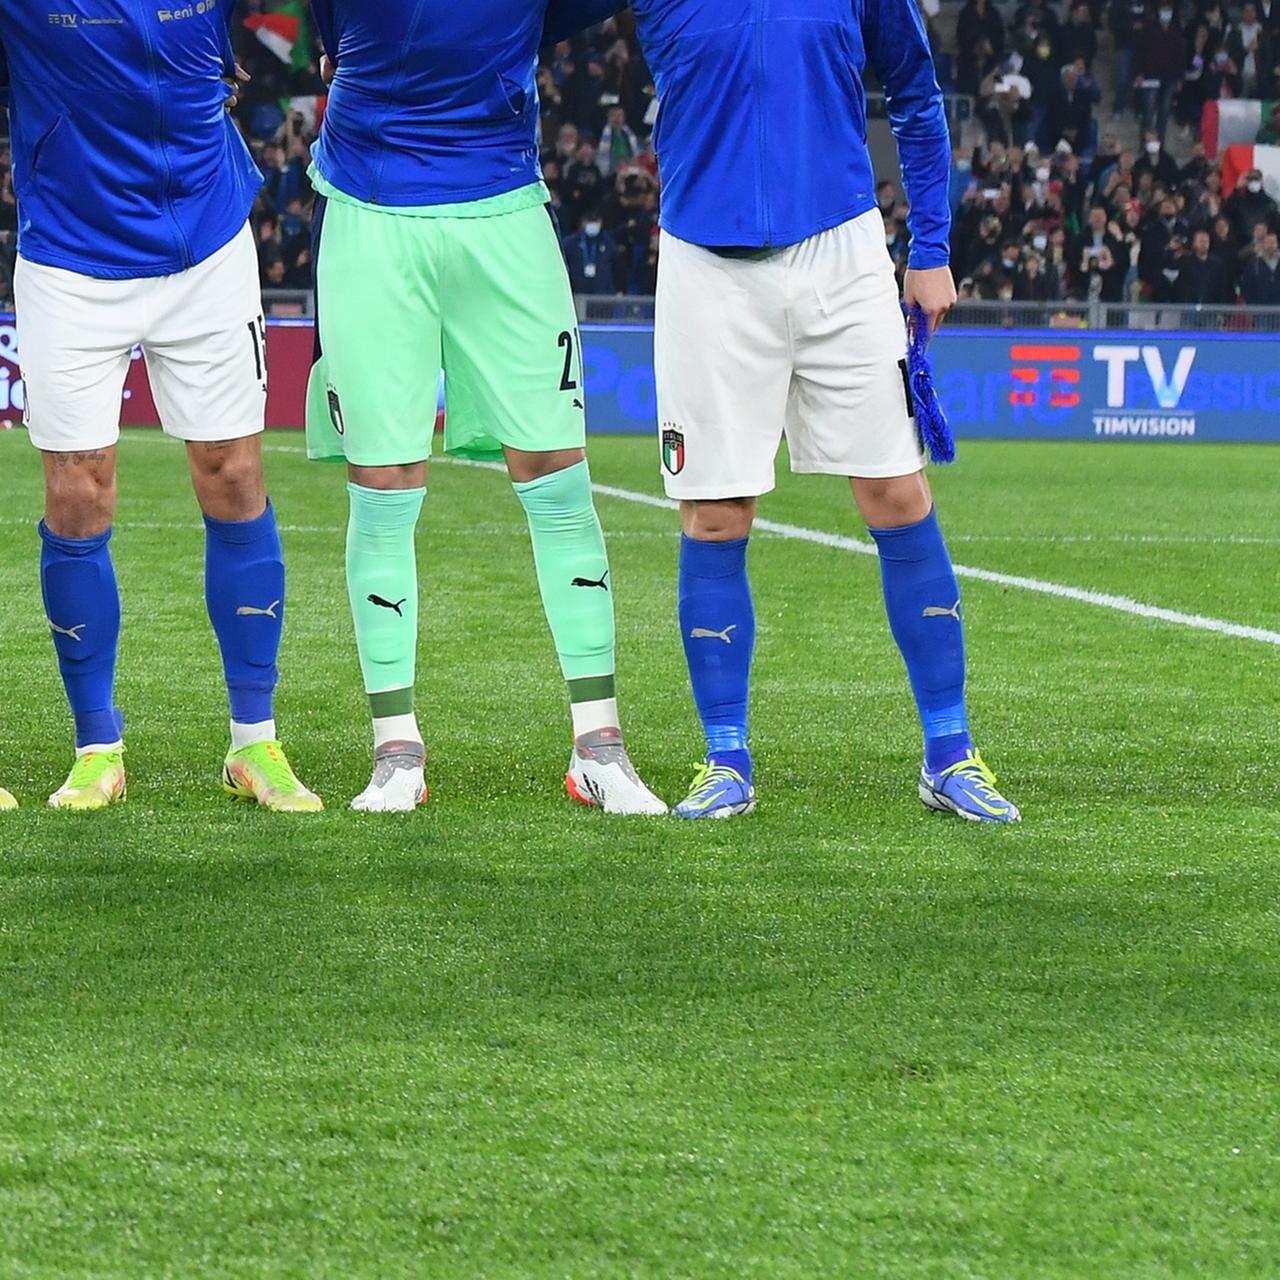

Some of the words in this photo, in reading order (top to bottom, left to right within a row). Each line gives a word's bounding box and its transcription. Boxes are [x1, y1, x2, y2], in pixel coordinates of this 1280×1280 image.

[62, 14, 77, 24] TV
[174, 4, 194, 20] eni
[1093, 346, 1197, 409] TV
[897, 358, 914, 419] 1
[1093, 417, 1196, 436] TIMVISION
